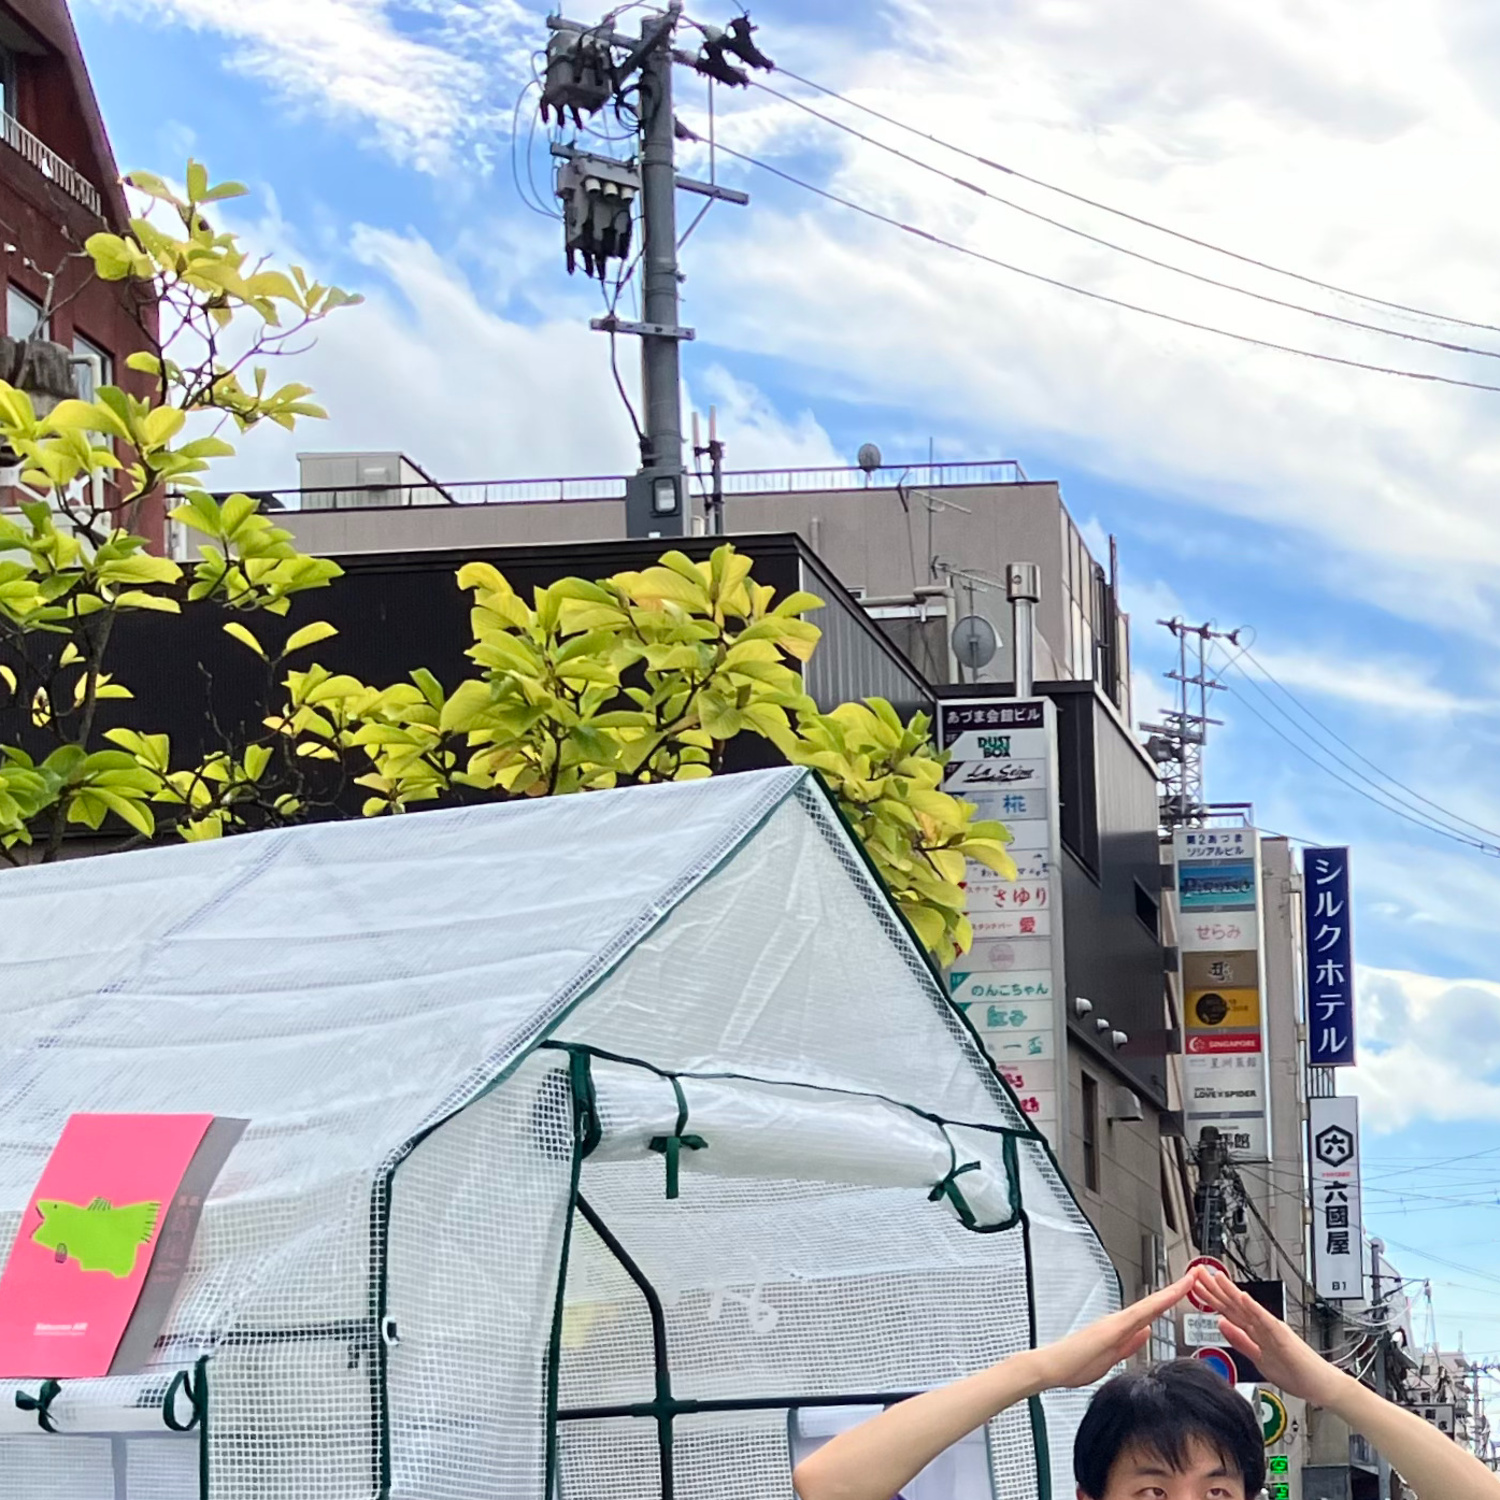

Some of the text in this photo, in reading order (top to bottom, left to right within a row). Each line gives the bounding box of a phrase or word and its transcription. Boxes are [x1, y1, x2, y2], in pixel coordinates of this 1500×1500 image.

[947, 707, 1040, 724] あづま会館ビル
[977, 735, 1011, 749] DUST
[983, 747, 1011, 759] BOX
[993, 886, 1047, 908] さゆり
[1196, 923, 1242, 941] せらみ
[1314, 858, 1348, 1053] シルクホテル
[971, 983, 1049, 997] のんこちゃん
[1324, 1180, 1350, 1256] 六國屋
[1331, 1281, 1347, 1291] B1
